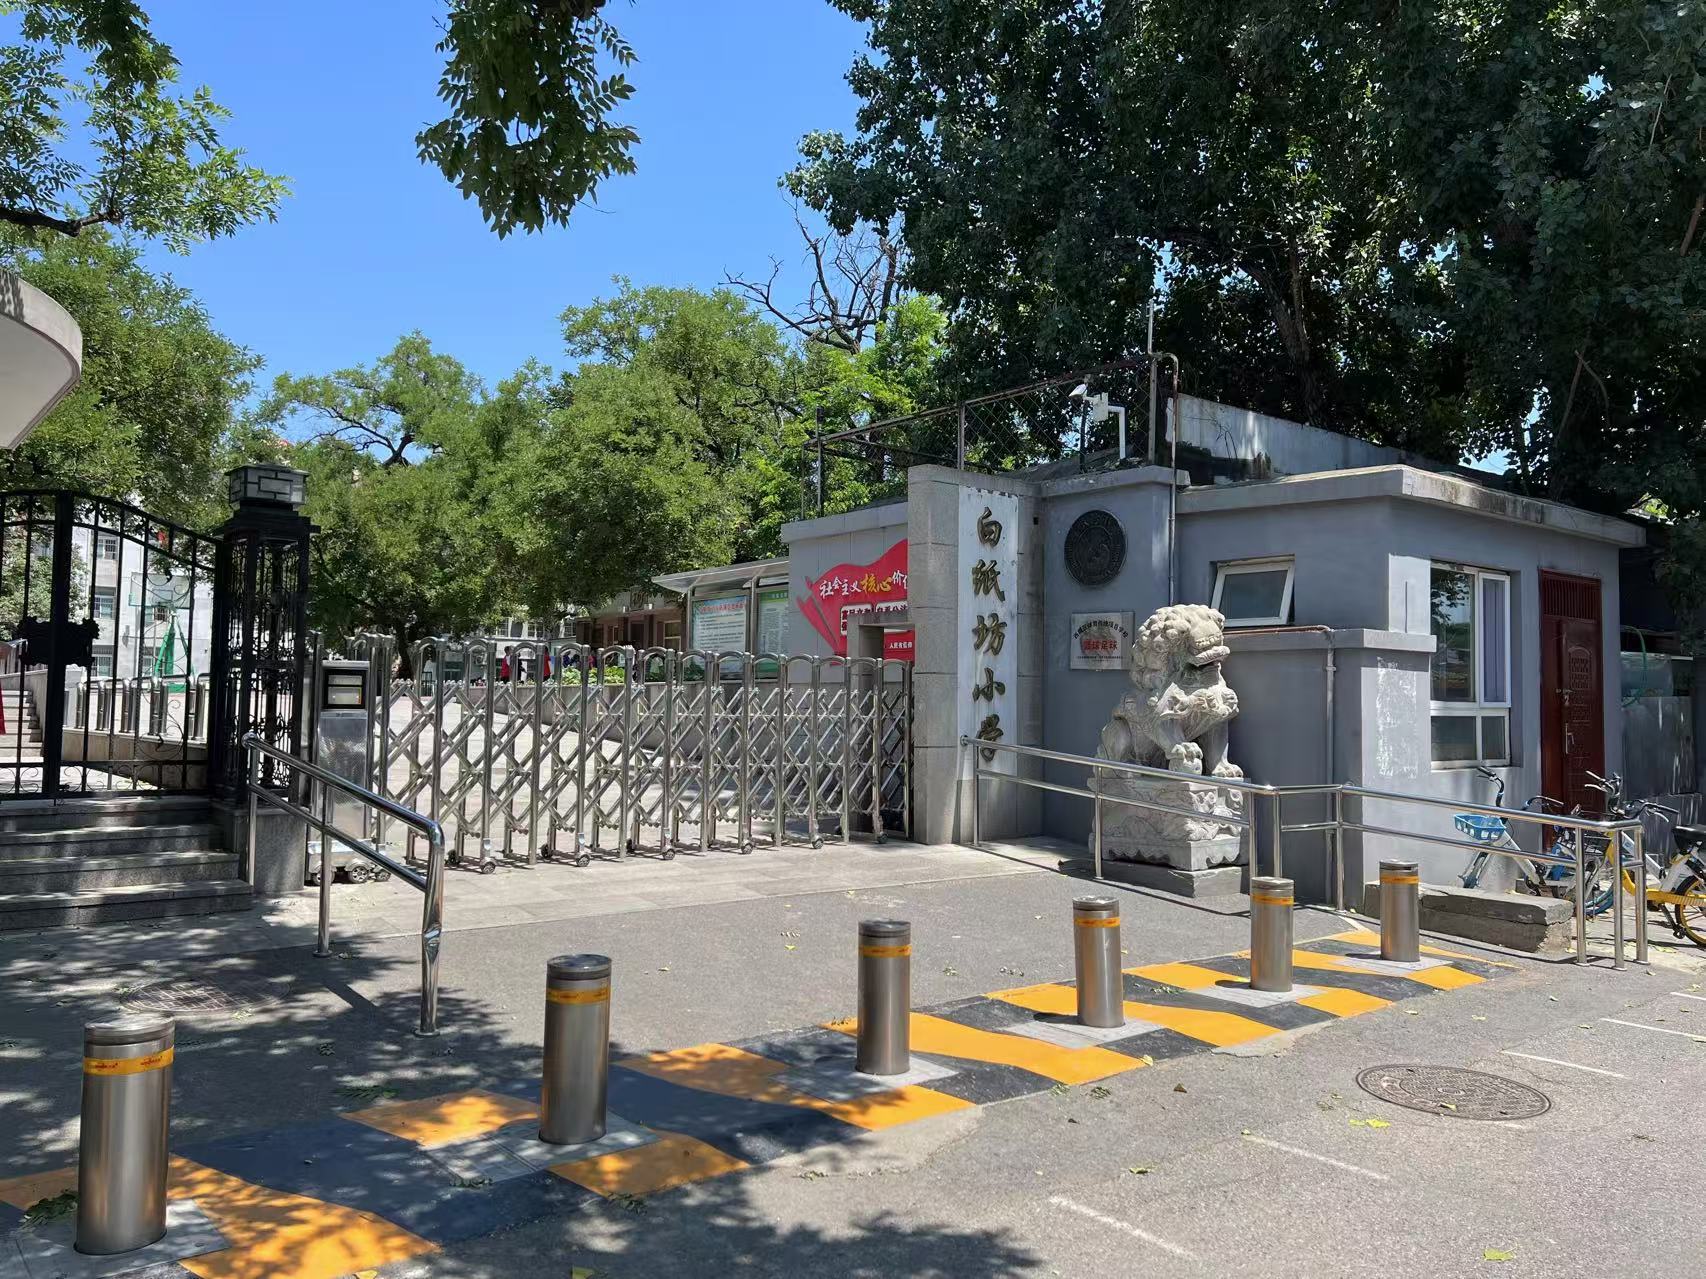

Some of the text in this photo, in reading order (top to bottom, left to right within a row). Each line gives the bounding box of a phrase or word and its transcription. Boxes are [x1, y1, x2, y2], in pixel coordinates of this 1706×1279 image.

[970, 506, 1008, 762] 白纸坊小学
